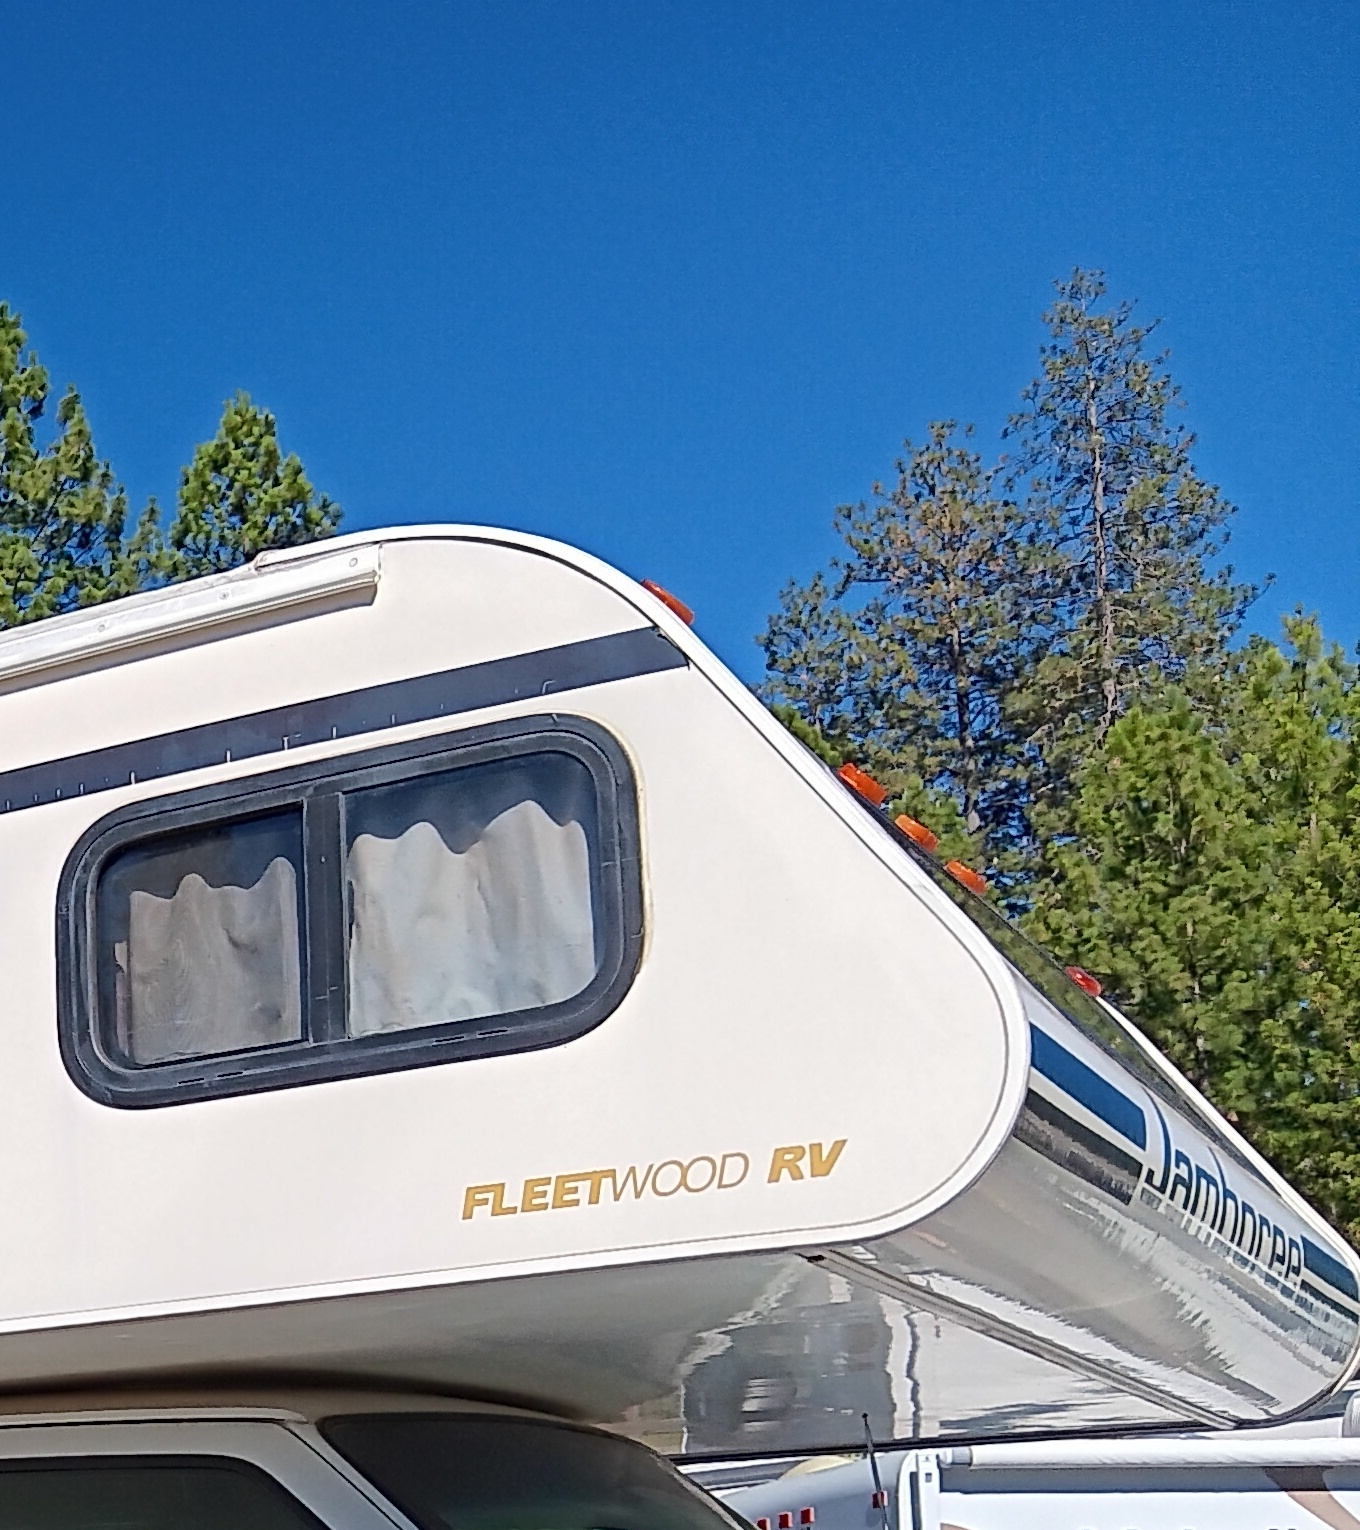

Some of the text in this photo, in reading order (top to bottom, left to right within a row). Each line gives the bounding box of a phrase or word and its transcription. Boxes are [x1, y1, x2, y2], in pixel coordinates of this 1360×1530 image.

[462, 1139, 848, 1220] FLEETWOOD RV
[1140, 1086, 1302, 1297] Jamboree
